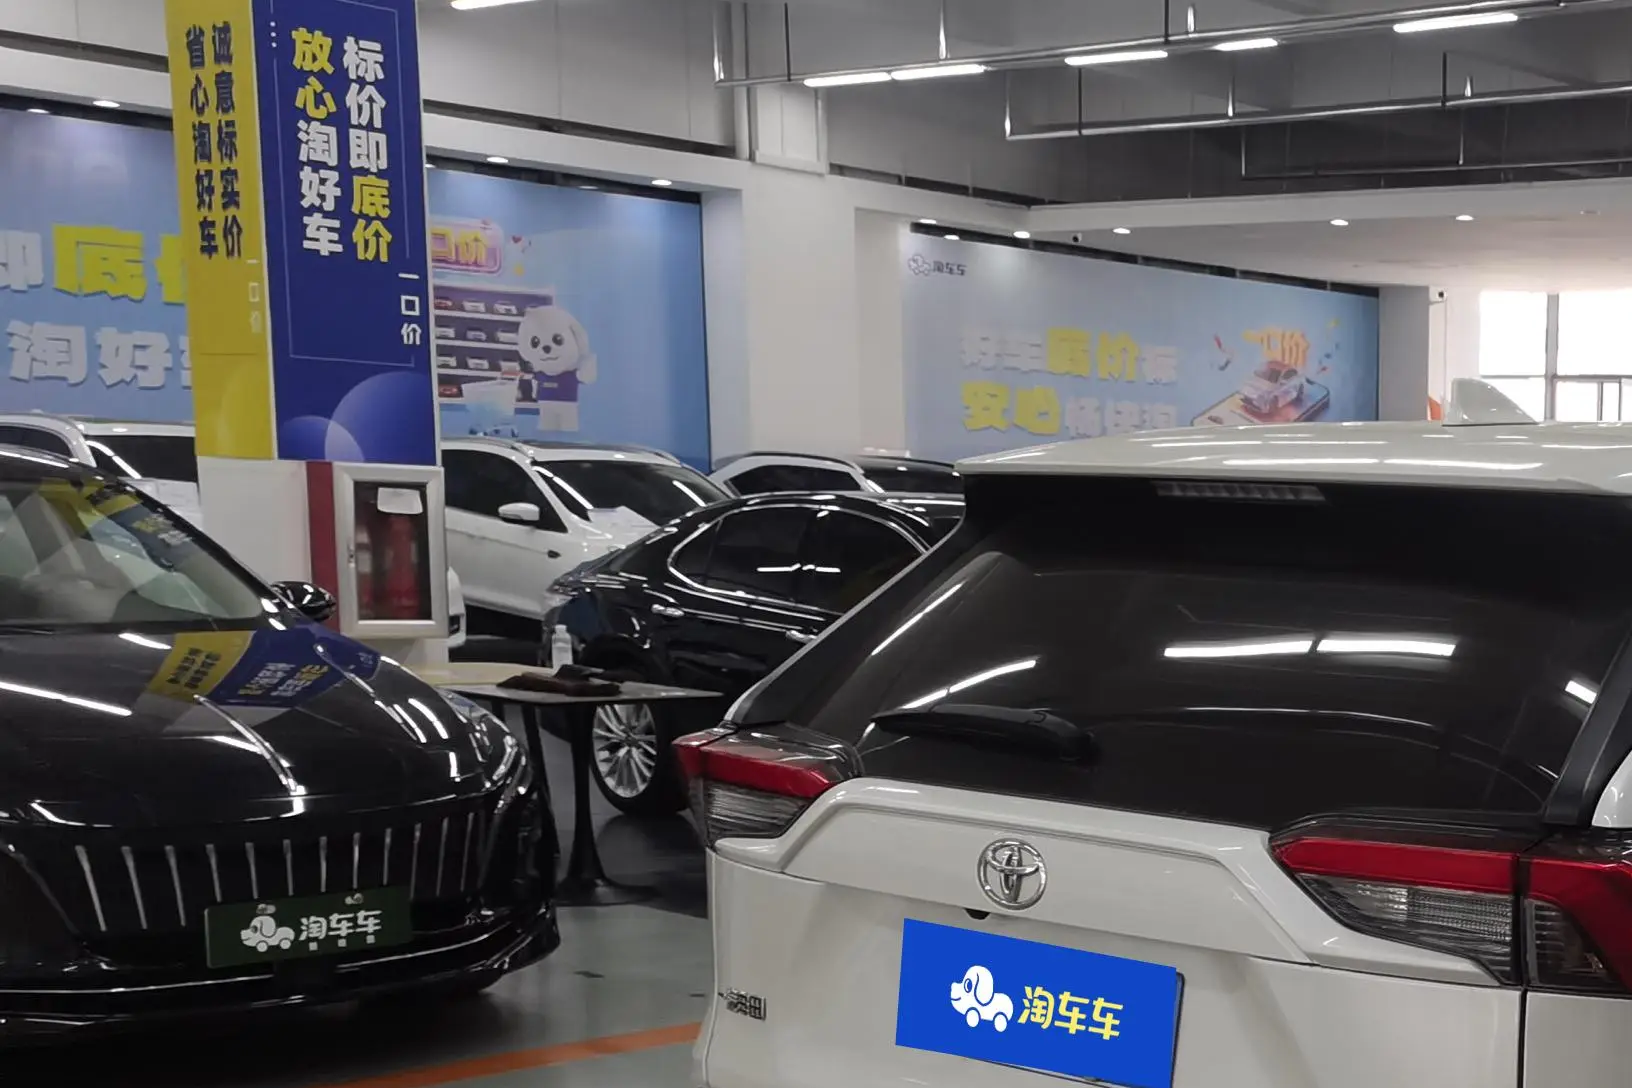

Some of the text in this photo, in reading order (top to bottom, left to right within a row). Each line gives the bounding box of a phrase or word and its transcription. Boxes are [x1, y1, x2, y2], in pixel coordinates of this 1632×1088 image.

[186, 24, 219, 259] 省心淘好车
[212, 21, 243, 259] 诚意标实价
[292, 27, 344, 256] 放心淘好车
[343, 36, 393, 263] 标价即底价
[7, 320, 192, 389] 淘好
[398, 272, 422, 345] 一口价
[299, 910, 382, 941] 淘车车
